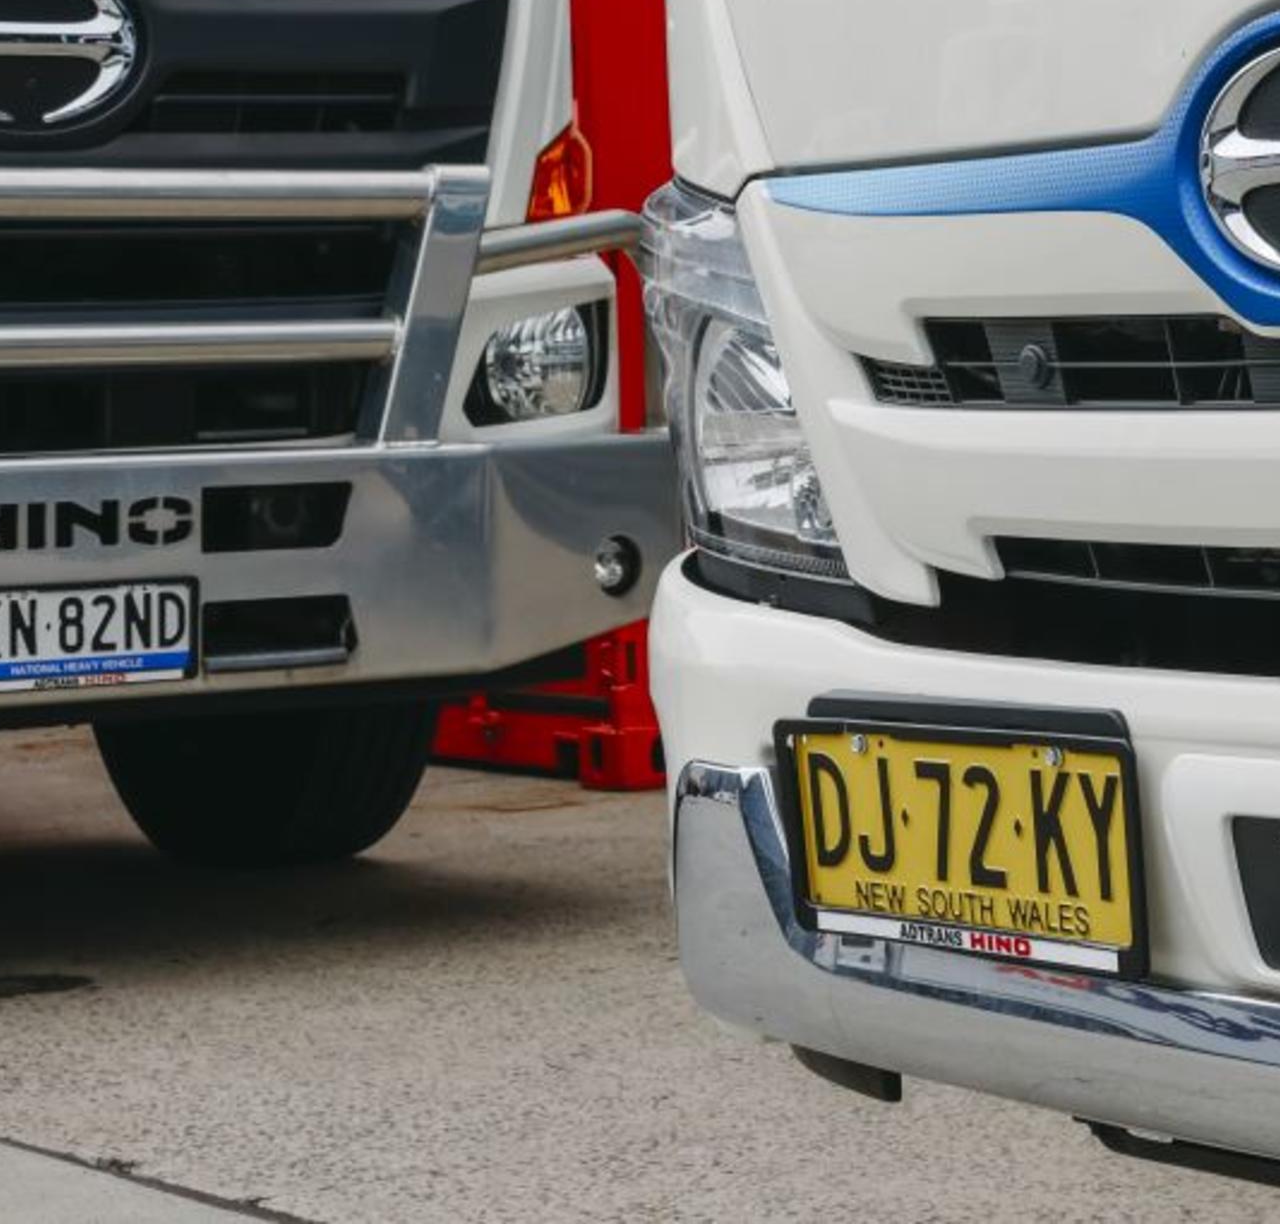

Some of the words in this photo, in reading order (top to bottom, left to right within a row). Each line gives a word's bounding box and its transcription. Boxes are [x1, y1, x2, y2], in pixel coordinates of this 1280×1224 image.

[10, 662, 62, 675] NATIONAL
[64, 660, 99, 672] HEAVY
[855, 880, 907, 911] NEW
[918, 887, 994, 926] SOUTH
[1007, 898, 1091, 936] WALES
[900, 923, 963, 947] ADTRANS
[969, 933, 1032, 956] HINO
